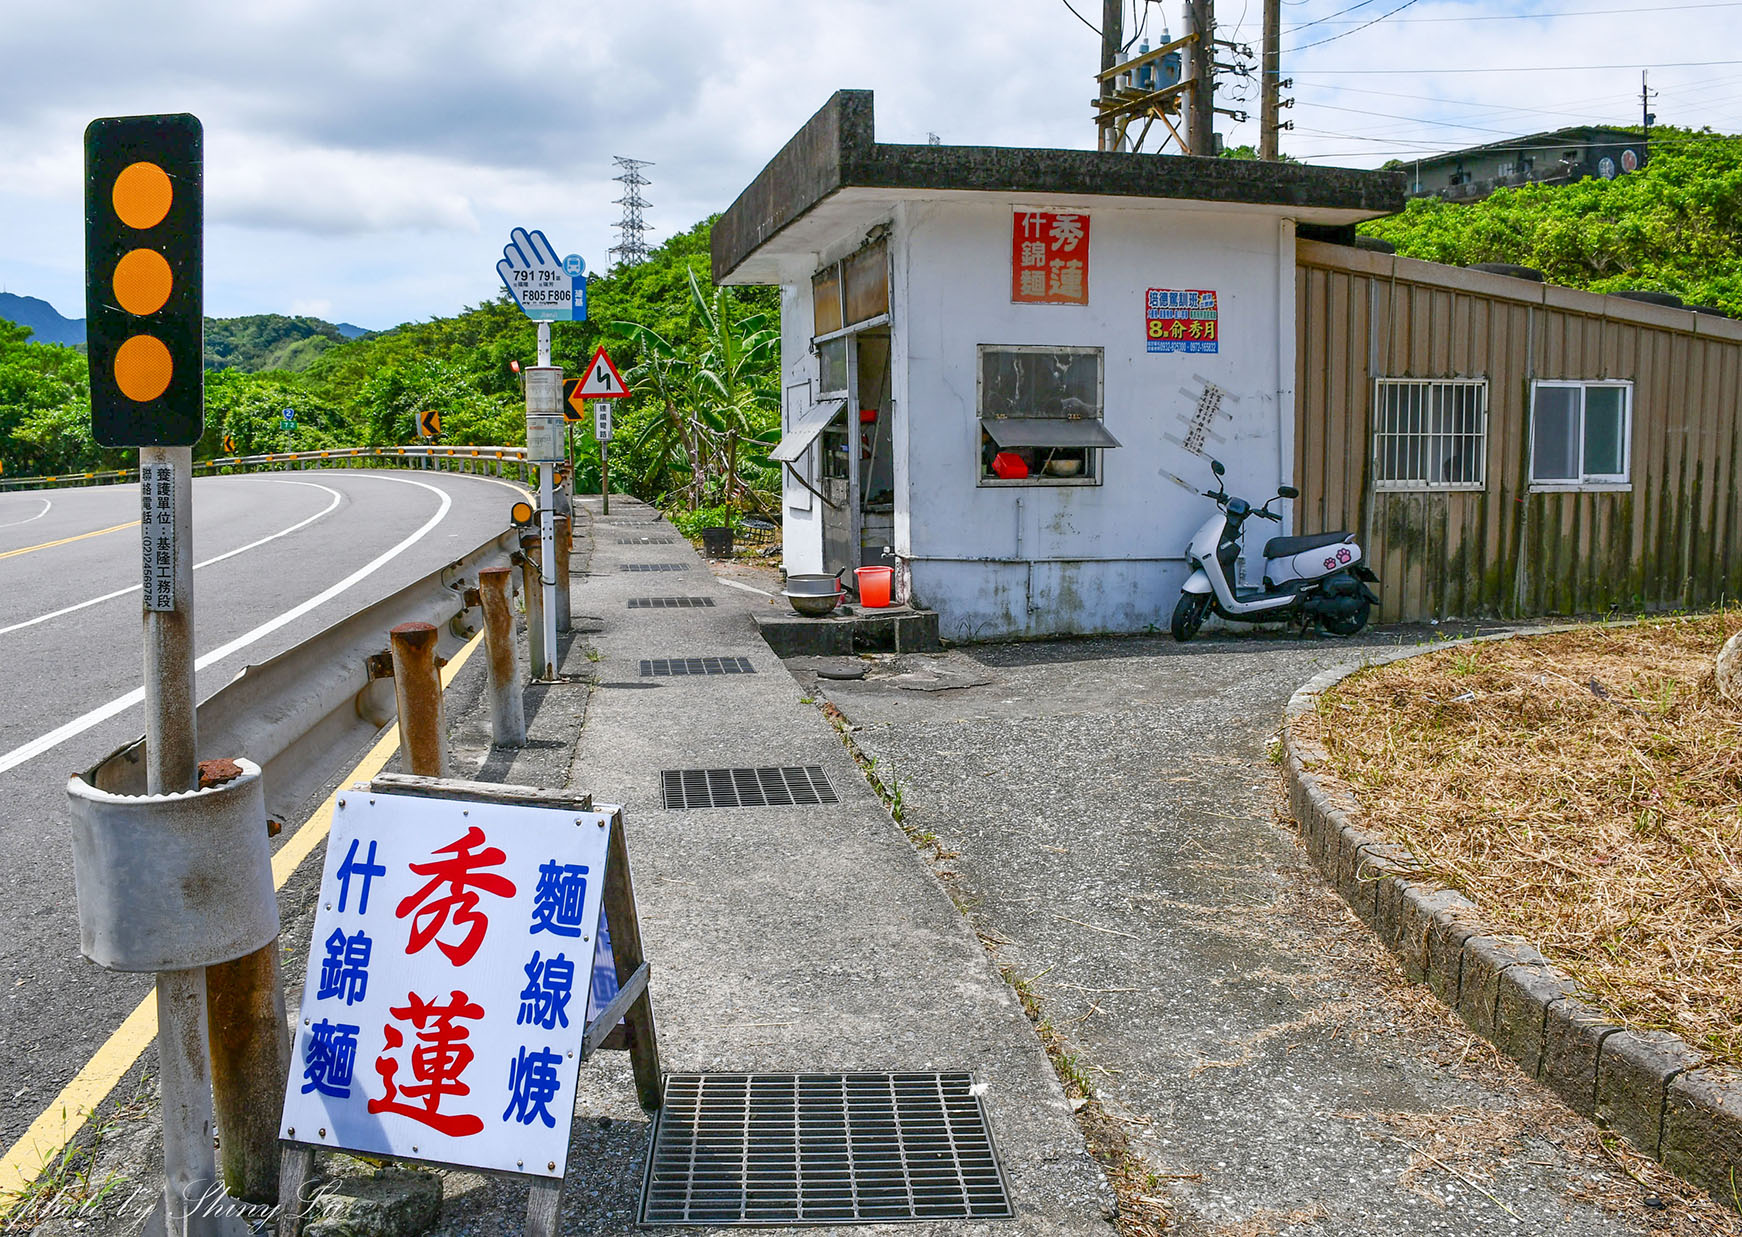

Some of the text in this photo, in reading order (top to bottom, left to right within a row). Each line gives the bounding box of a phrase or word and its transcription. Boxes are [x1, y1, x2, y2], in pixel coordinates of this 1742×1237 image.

[513, 270, 535, 281] 791
[538, 270, 556, 281] 791
[522, 290, 546, 301] F805
[548, 290, 571, 301] F806
[1021, 212, 1047, 296] 什錦麵
[1049, 214, 1084, 298] 秀蓮
[301, 838, 387, 1100] 什錦麵
[367, 826, 518, 1138] 秀蓮
[503, 859, 590, 1129] 麵線焿
